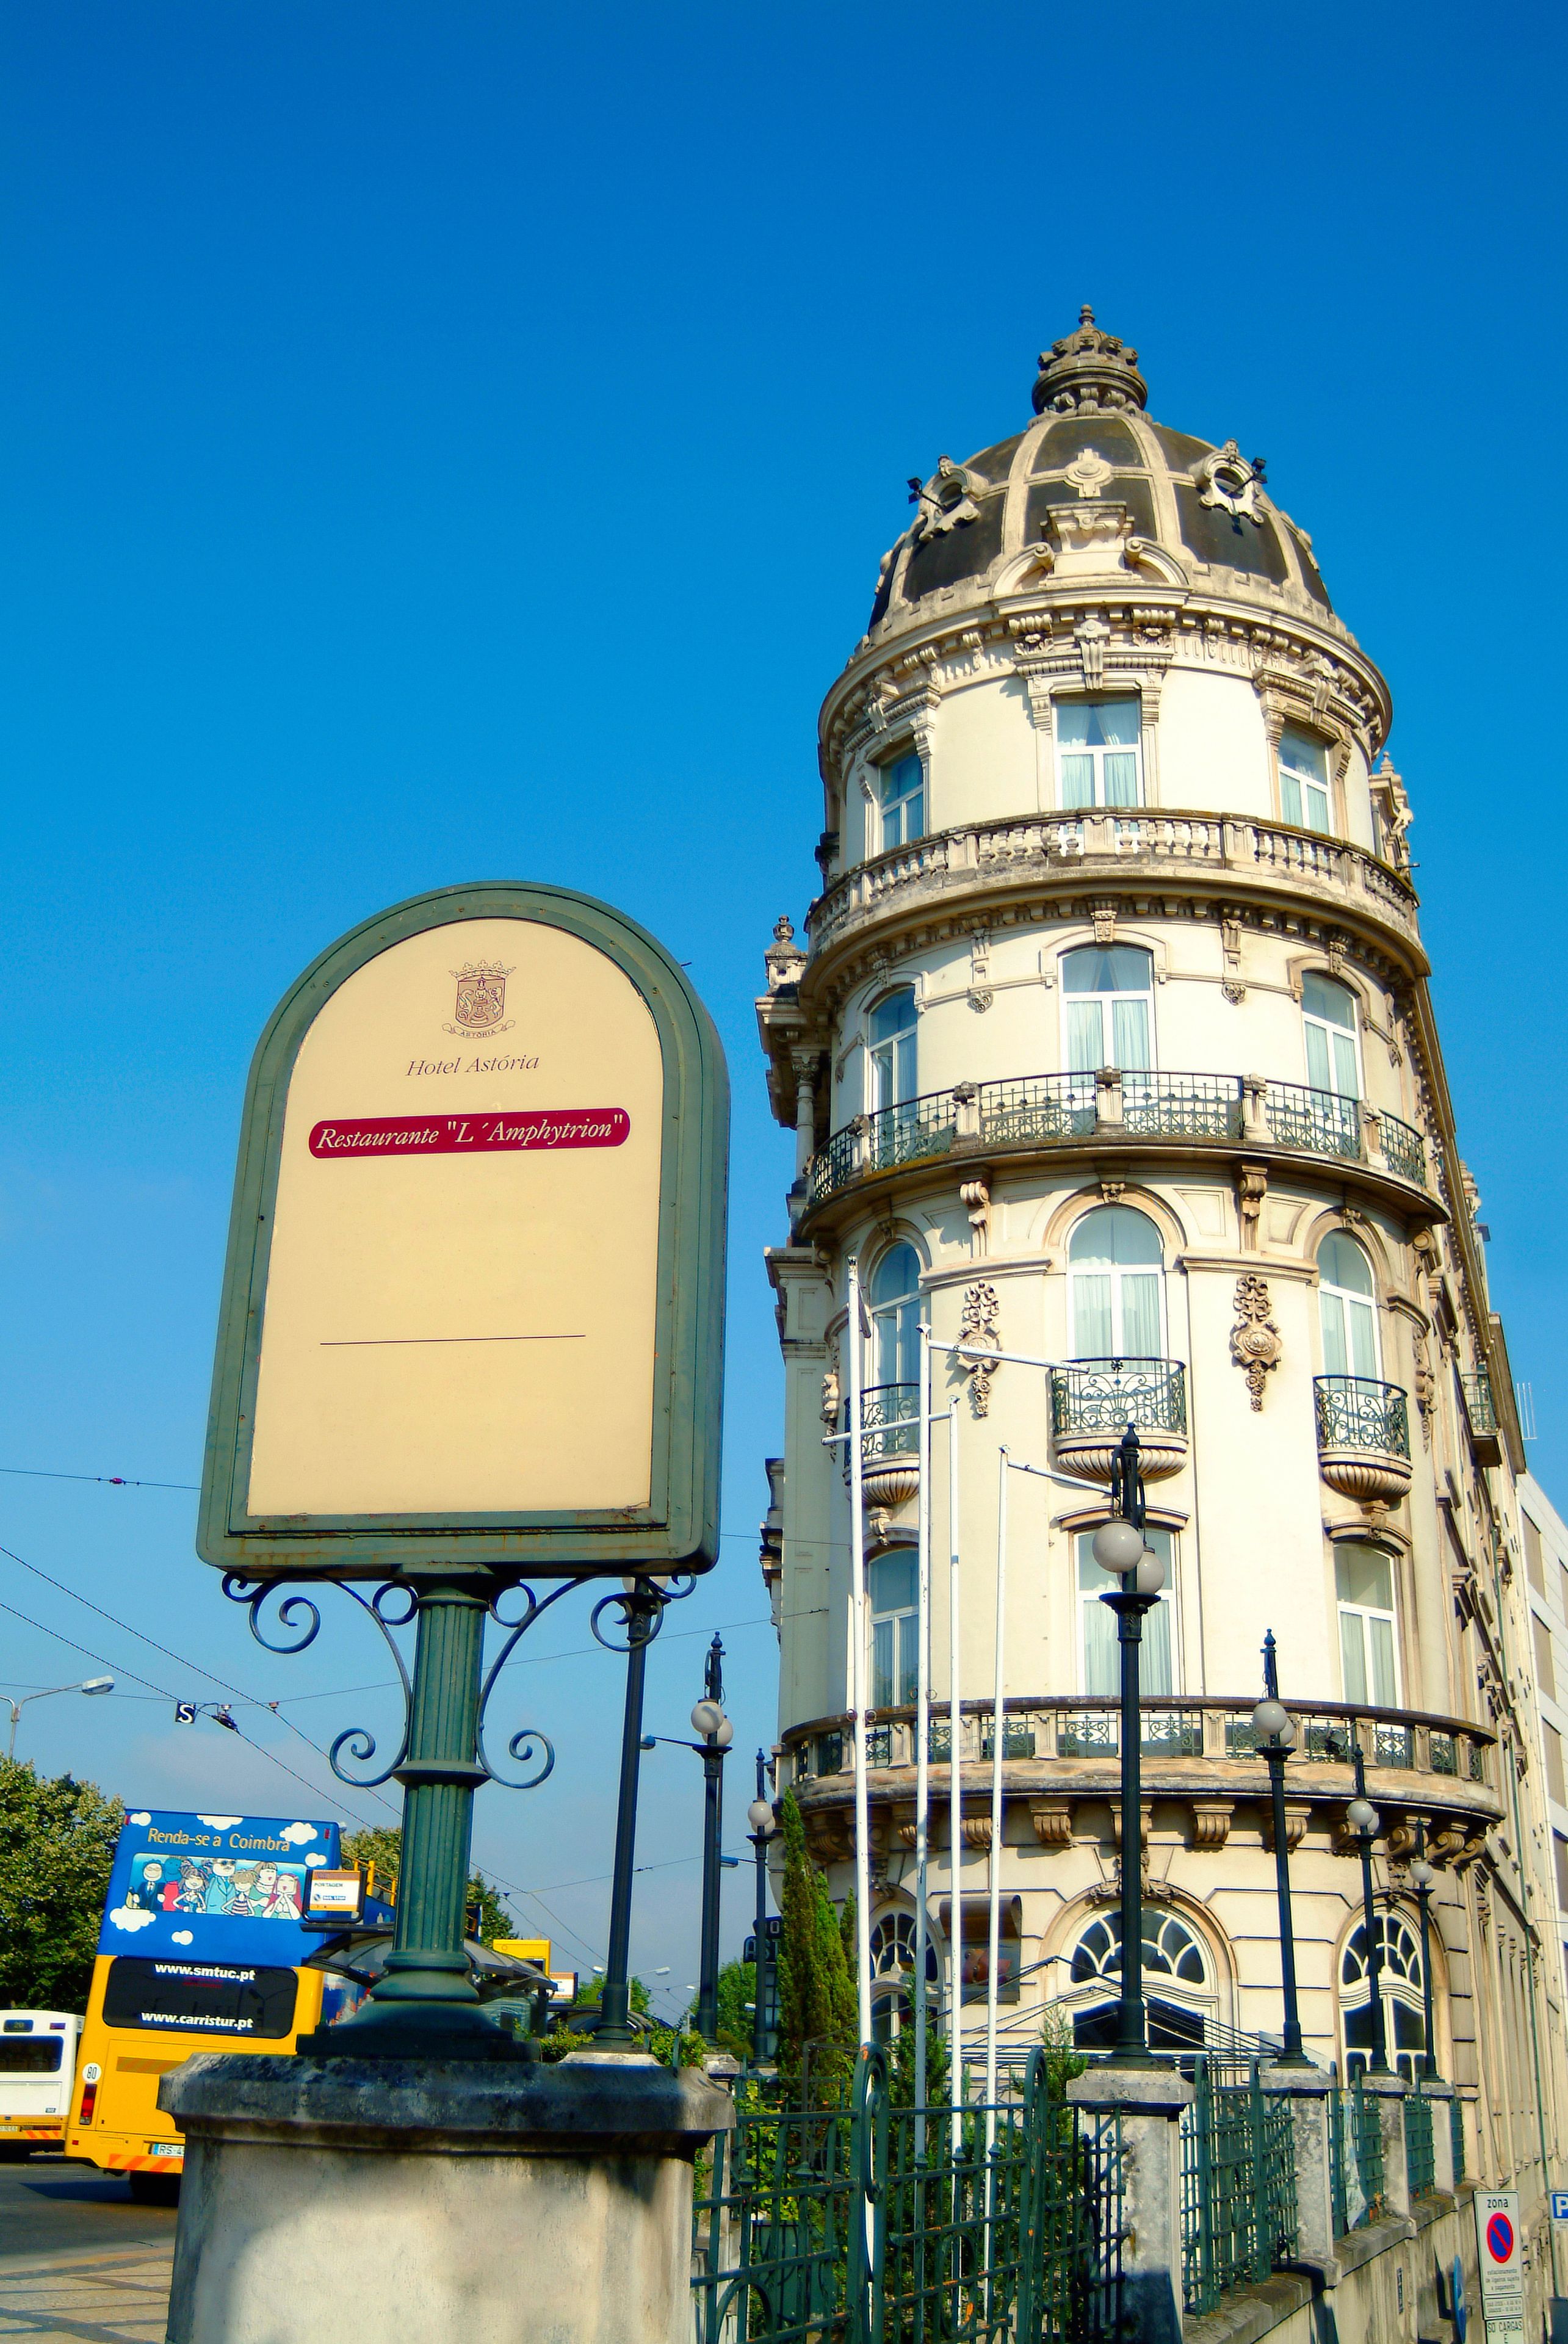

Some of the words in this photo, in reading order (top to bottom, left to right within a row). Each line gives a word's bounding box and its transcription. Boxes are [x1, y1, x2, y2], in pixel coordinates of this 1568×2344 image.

[406, 1057, 460, 1076] Hotel
[465, 1054, 540, 1073] Astória
[315, 1127, 439, 1149] Restaurante
[178, 1704, 194, 1723] S
[147, 1827, 211, 1847] Renda-se
[212, 1835, 222, 1847] a
[229, 1832, 291, 1852] Coimbra
[154, 1963, 256, 1983] www.smtuc.pt
[141, 2011, 254, 2031] www.carristur.pt
[1487, 2198, 1509, 2208] zona
[1555, 2196, 1568, 2217] P
